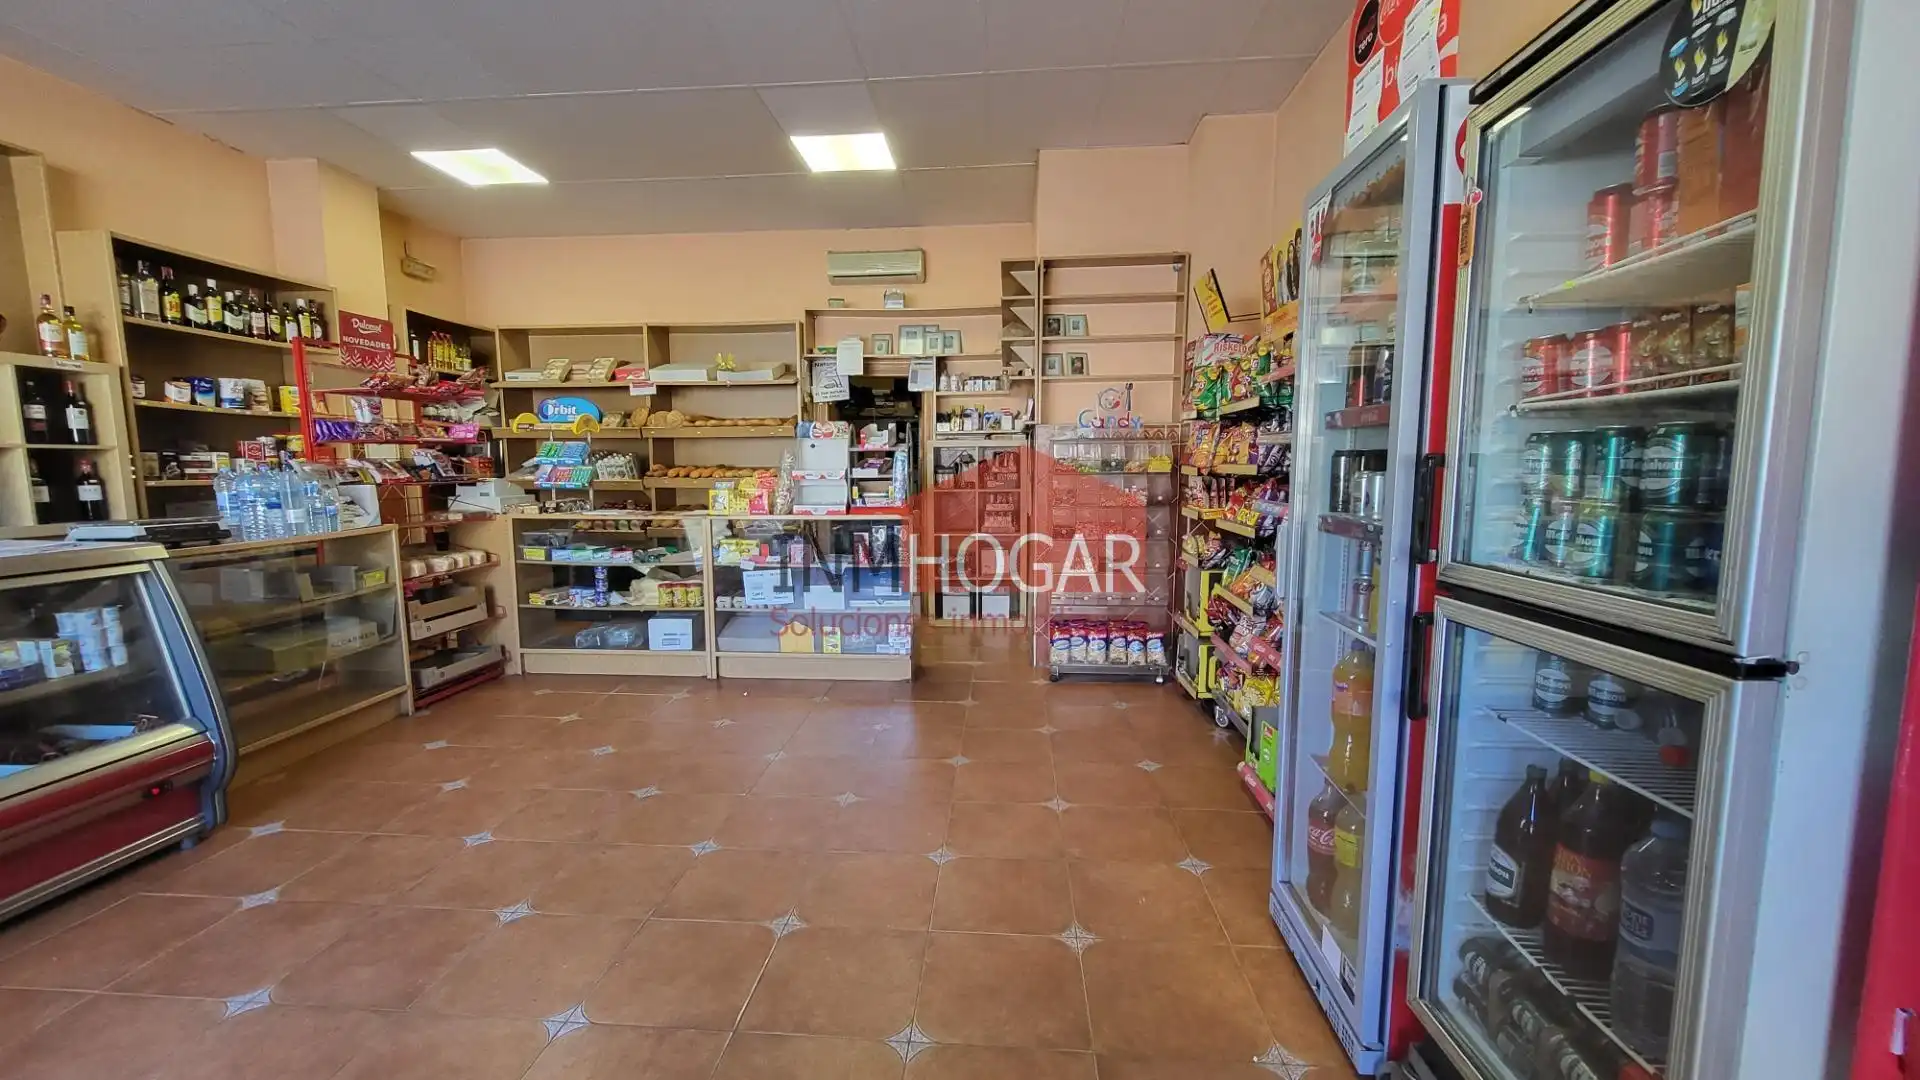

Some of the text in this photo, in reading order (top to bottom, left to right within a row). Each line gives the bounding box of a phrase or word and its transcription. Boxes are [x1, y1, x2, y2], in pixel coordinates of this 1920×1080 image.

[1358, 32, 1373, 54] zero
[342, 335, 391, 350] NOVEDADES
[542, 403, 577, 416] Orbit
[1079, 409, 1144, 432] Candy
